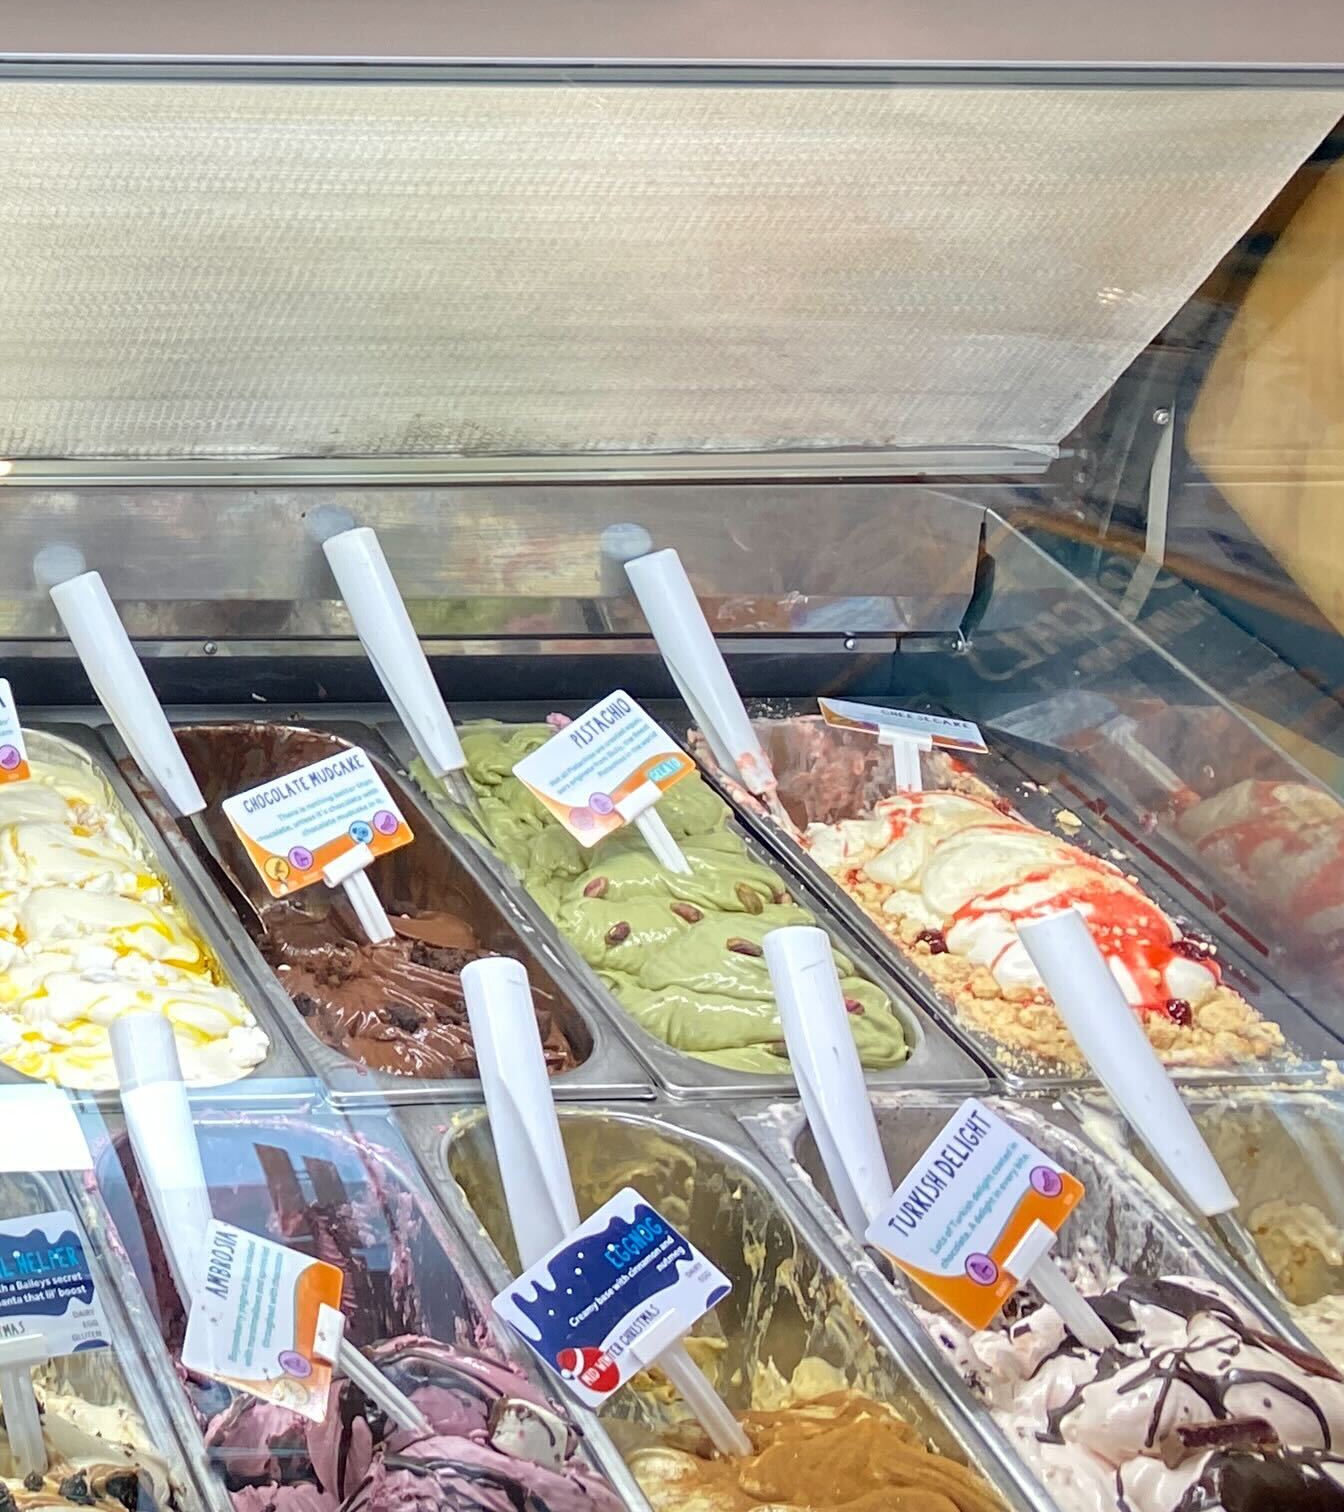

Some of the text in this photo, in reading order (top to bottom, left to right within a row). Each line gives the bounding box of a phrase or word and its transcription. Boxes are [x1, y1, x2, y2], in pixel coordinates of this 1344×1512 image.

[570, 697, 632, 749] PISTACHIO
[243, 776, 310, 814] CHOCOLATE
[308, 754, 364, 788] MUDCAKE
[888, 1109, 991, 1237] TURKISH DELIGHT
[206, 1230, 238, 1300] AMBROSIA
[604, 1216, 662, 1270] EGGNOG
[16, 1277, 51, 1292] Baileys
[52, 1272, 83, 1284] secret
[58, 1285, 87, 1297] boost
